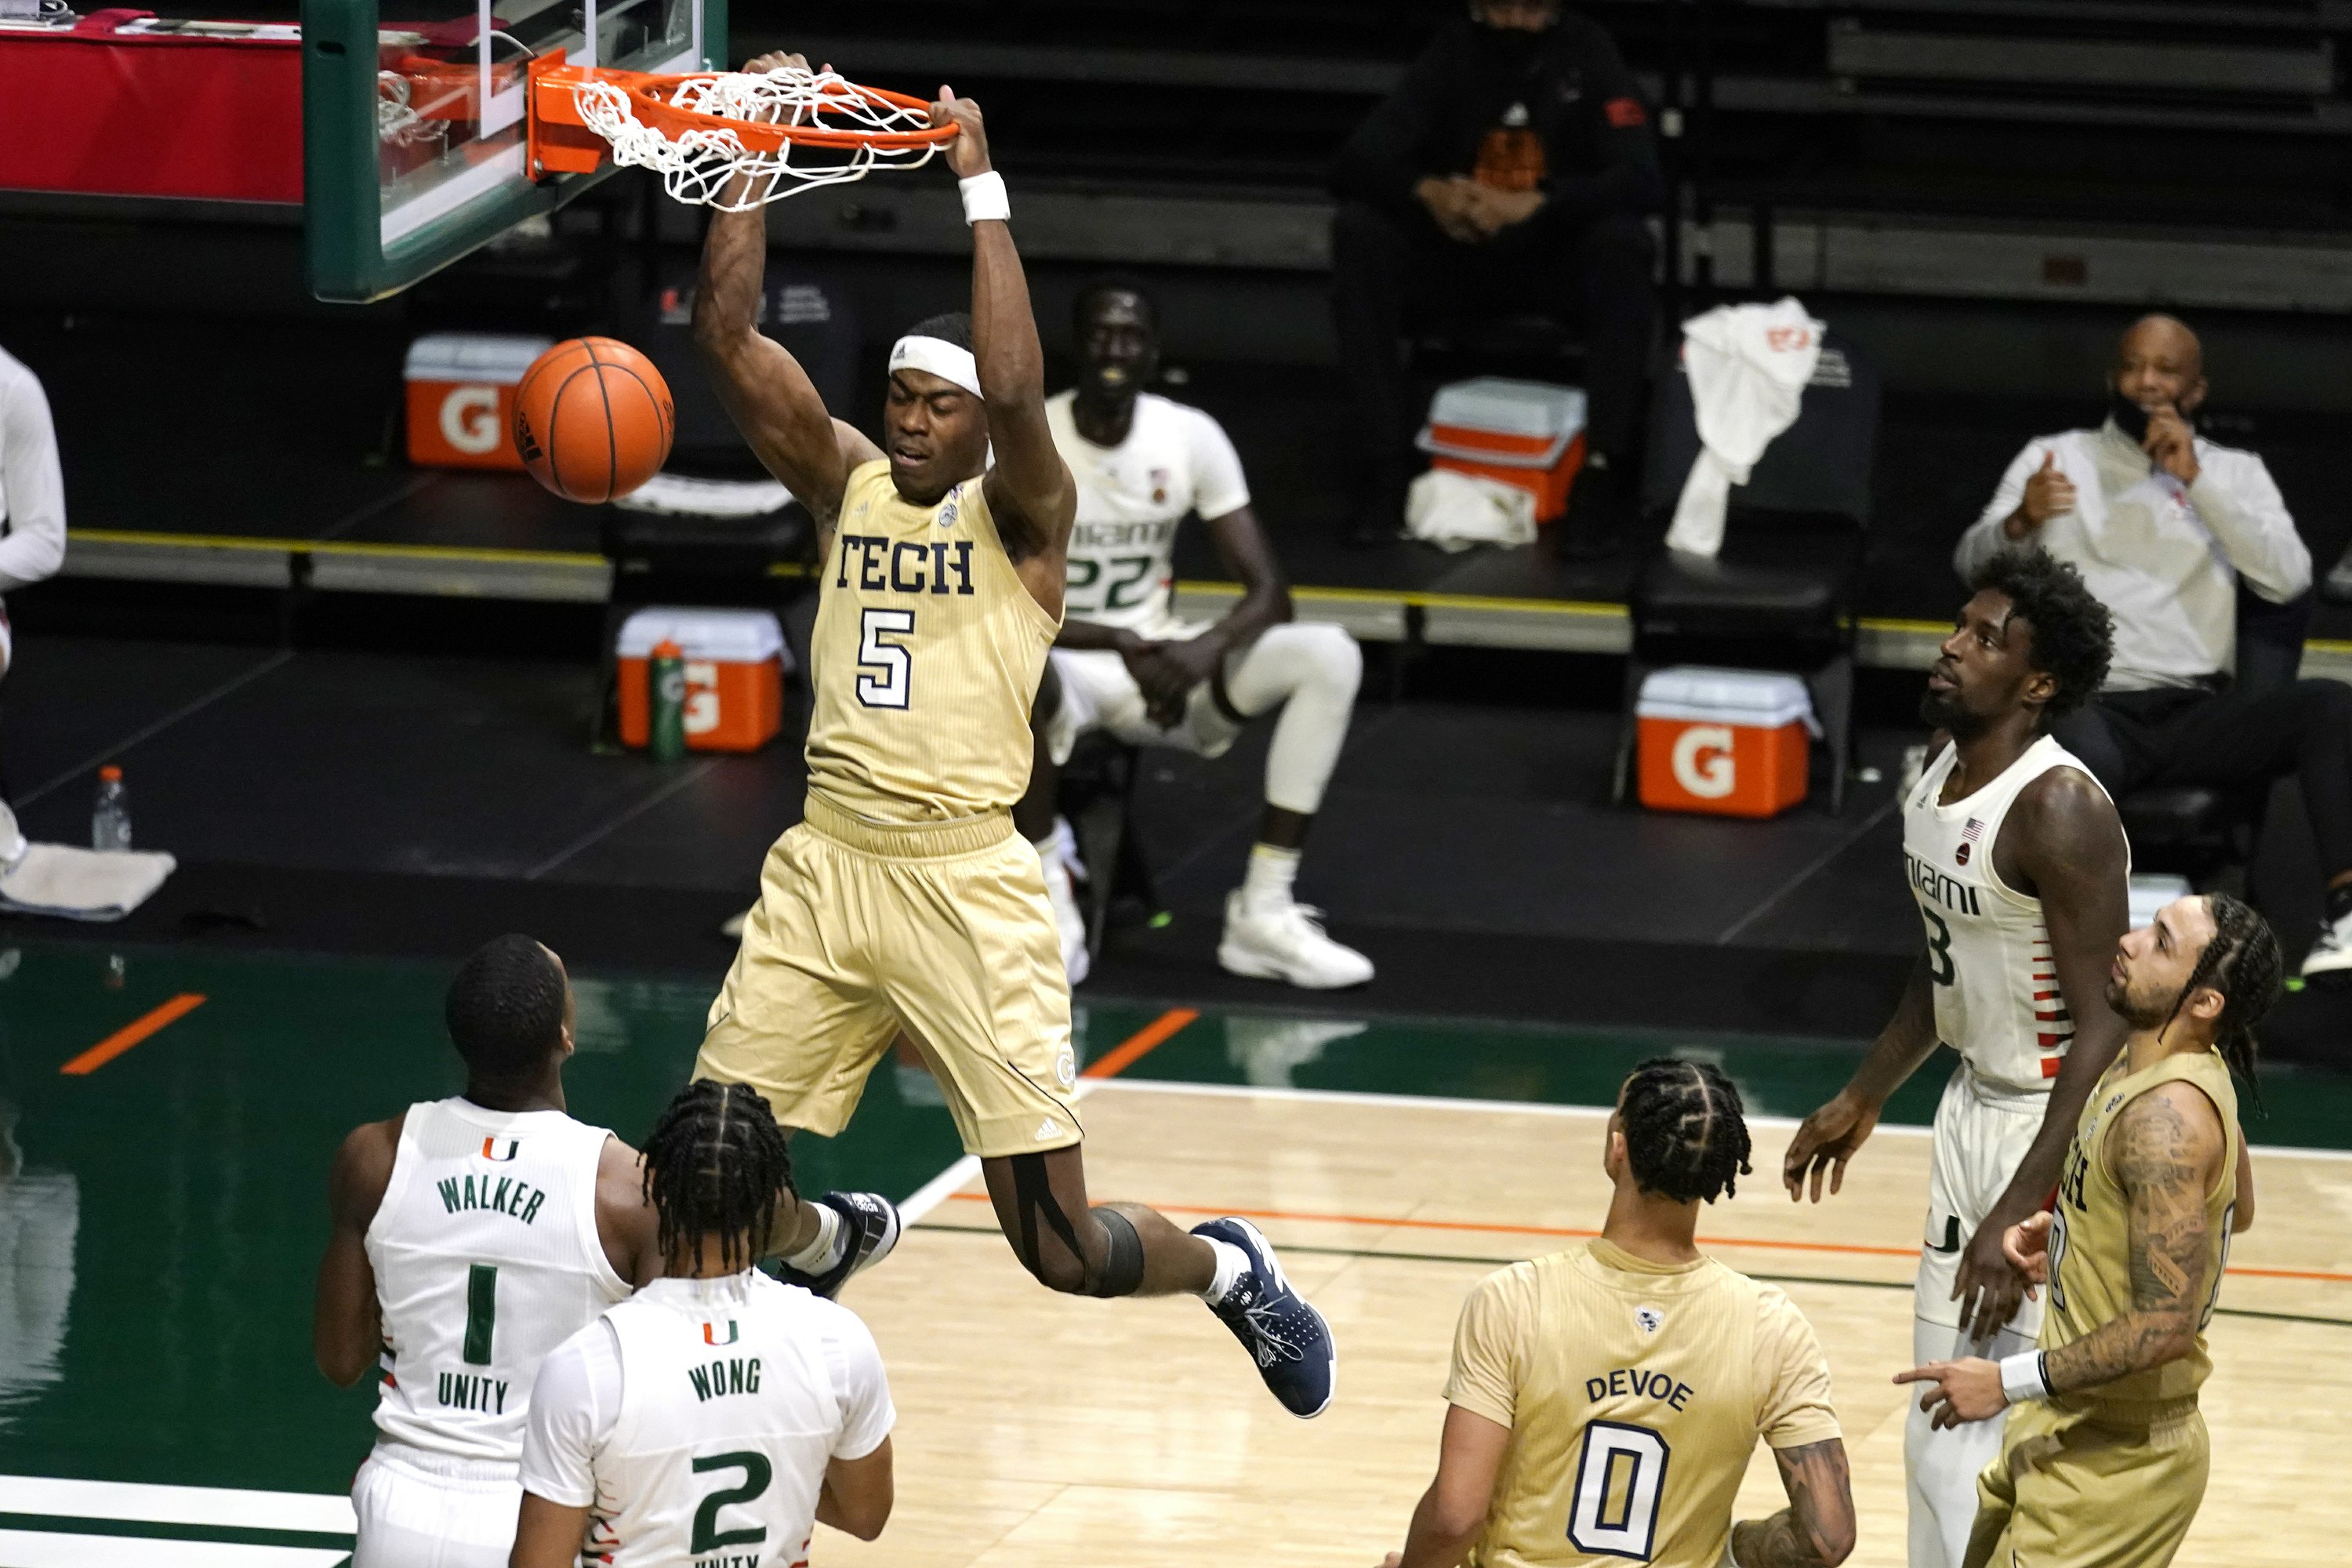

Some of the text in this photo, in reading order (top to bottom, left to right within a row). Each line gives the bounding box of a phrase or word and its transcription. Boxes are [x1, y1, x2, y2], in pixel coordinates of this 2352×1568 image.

[439, 387, 502, 455] G
[837, 534, 975, 595] TECH
[1065, 554, 1152, 610] 22
[855, 608, 915, 711] 5
[1671, 726, 1736, 798] G
[1922, 904, 1955, 986] 3
[481, 1136, 519, 1162] U
[437, 1174, 546, 1225] WALKER
[463, 1265, 498, 1366] 1
[702, 1319, 739, 1346] U
[438, 1372, 508, 1415] UNITY
[688, 1357, 761, 1403] WONG
[1586, 1369, 1694, 1412] DEVOE
[691, 1450, 772, 1555] 2
[1566, 1419, 1671, 1563] 0
